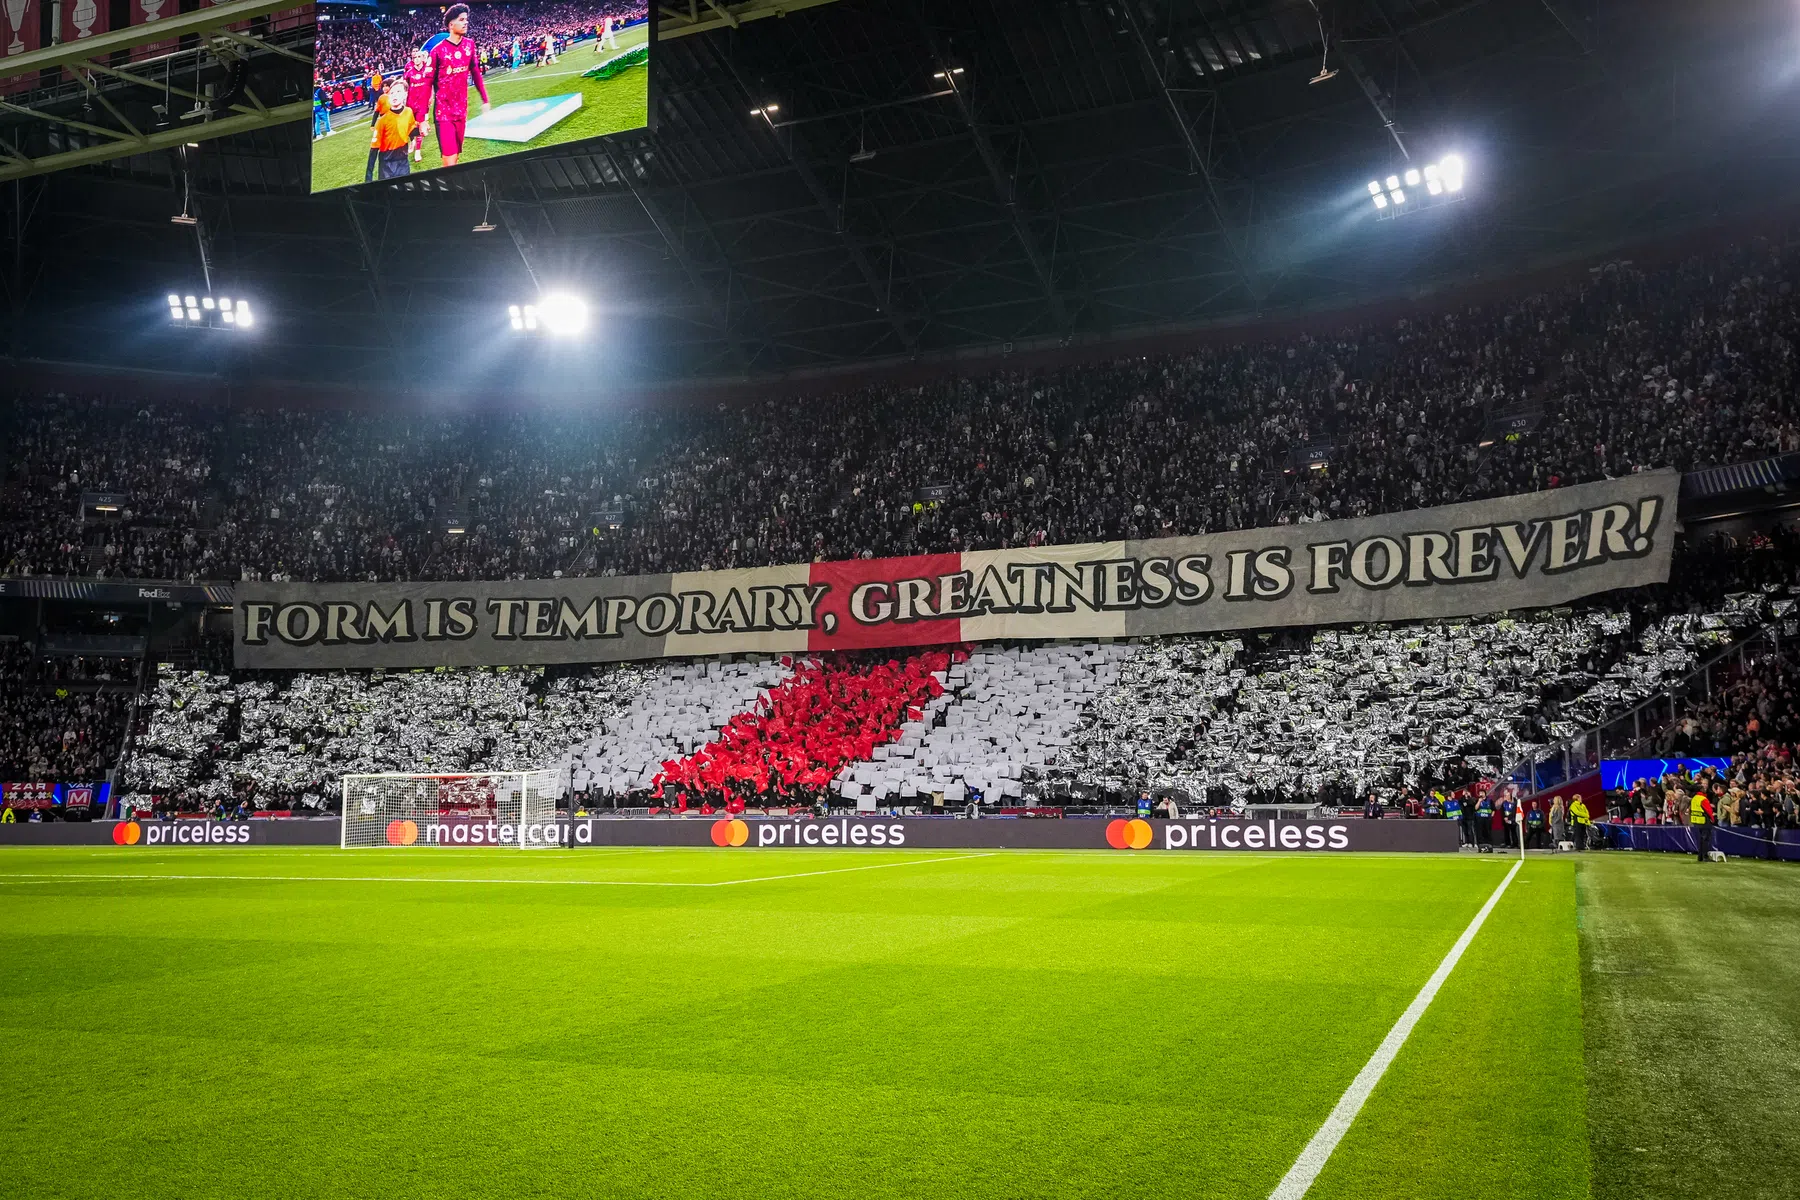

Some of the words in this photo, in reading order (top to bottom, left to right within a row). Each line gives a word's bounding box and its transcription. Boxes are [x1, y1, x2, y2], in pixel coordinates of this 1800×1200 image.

[1511, 419, 1527, 428] 430
[1309, 451, 1323, 459] 429
[930, 488, 943, 496] 428
[242, 598, 418, 646] FORM
[423, 598, 479, 642] IS
[487, 581, 838, 642] TEMPORARY,
[850, 555, 1214, 627] GREATNESS
[1225, 545, 1295, 600] IS
[1306, 496, 1664, 591] FOREVER!
[138, 588, 171, 599] FedEx
[11, 782, 46, 791] ZAR
[69, 791, 88, 804] M
[146, 821, 250, 845] priceless
[426, 819, 593, 844] mastercard
[758, 818, 905, 847] priceless
[1165, 818, 1349, 850] priceless
